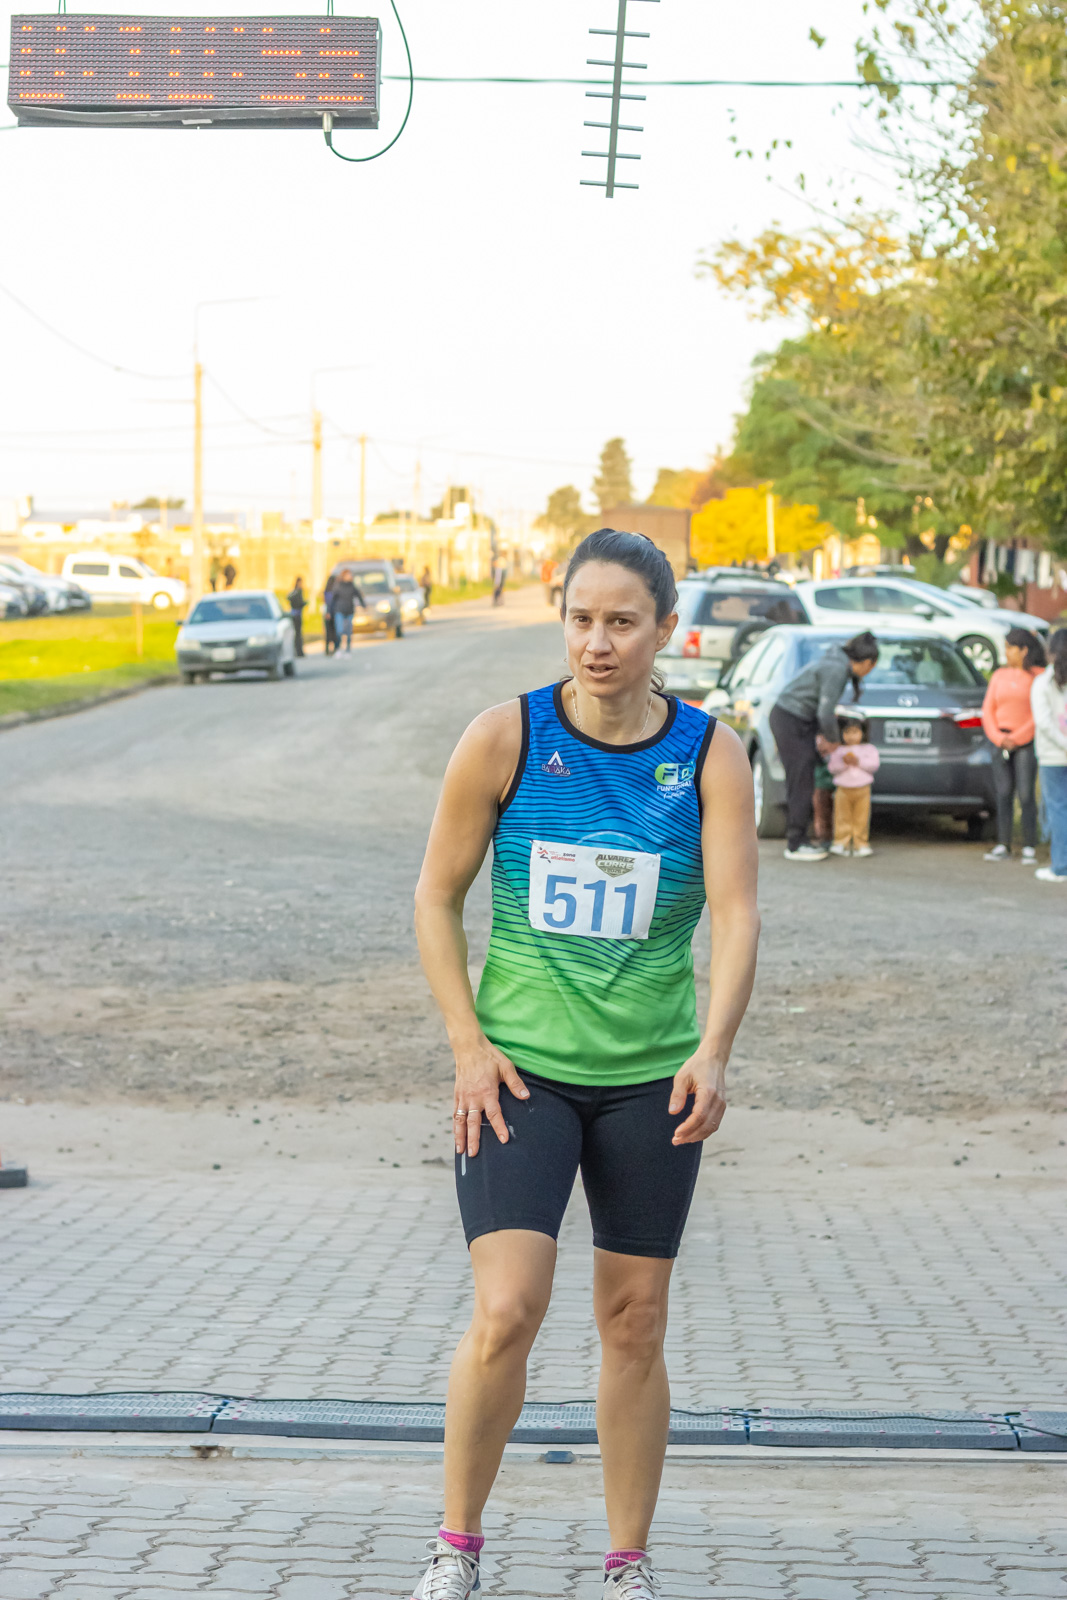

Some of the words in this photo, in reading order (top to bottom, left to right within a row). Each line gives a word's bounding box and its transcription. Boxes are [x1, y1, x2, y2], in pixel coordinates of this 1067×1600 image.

[656, 781, 692, 791] FUNCIONAL
[595, 854, 637, 863] ALVAREZ
[597, 860, 634, 870] CORRE
[543, 874, 637, 935] 511
